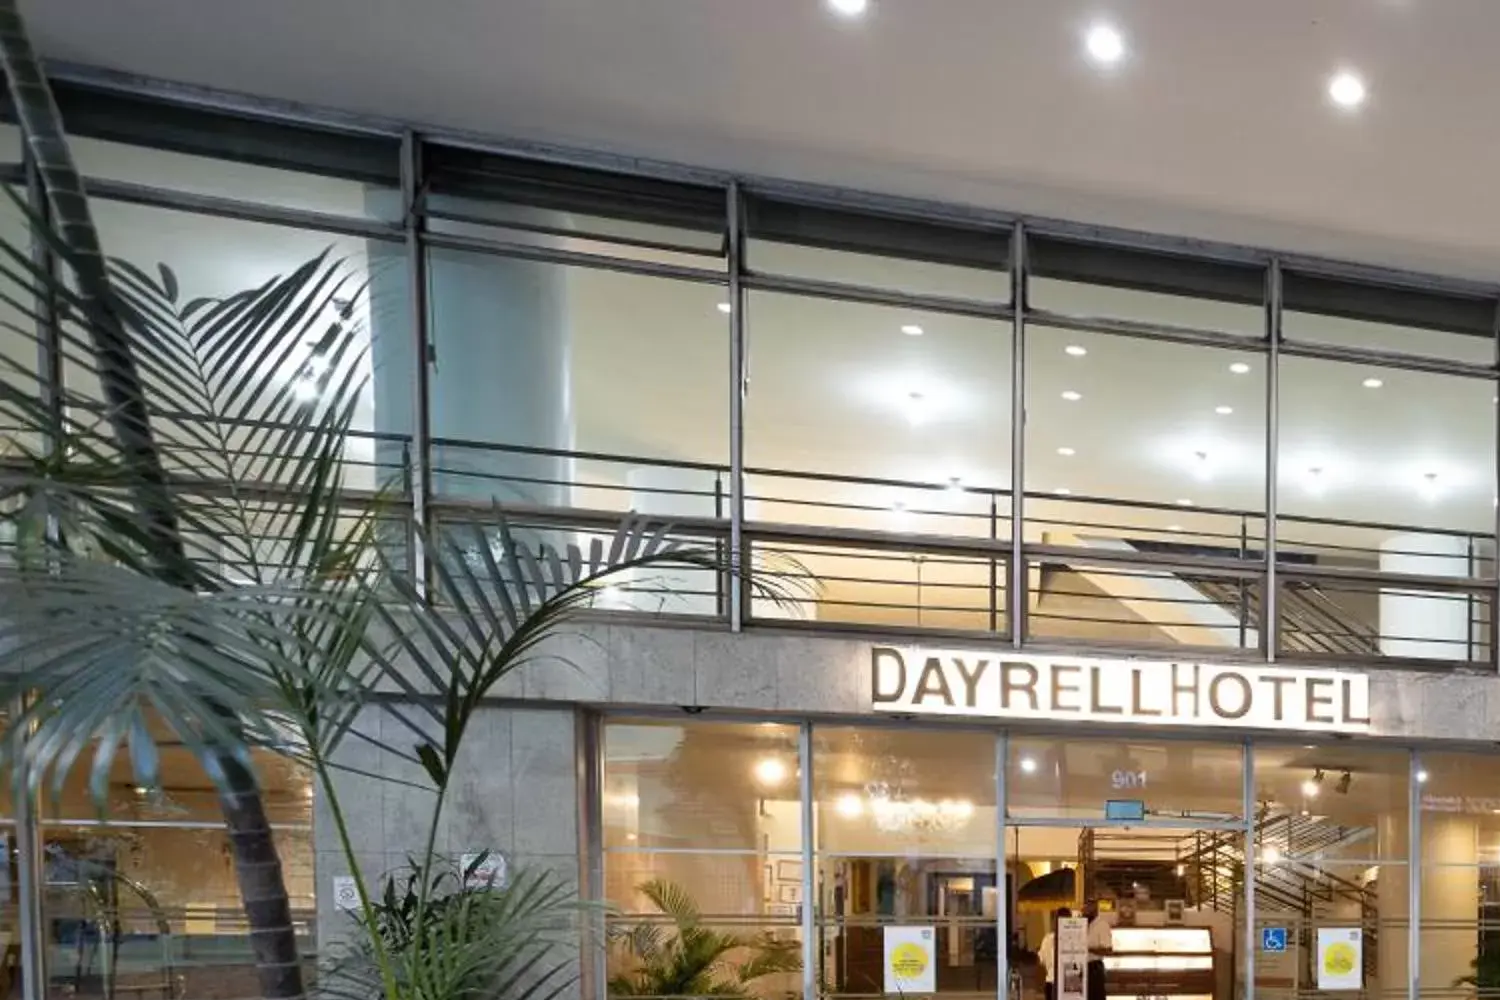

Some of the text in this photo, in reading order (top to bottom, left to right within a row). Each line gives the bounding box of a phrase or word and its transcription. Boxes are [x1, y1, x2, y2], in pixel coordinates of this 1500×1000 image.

[872, 647, 1370, 726] DAYRELL HOTEL
[1112, 769, 1147, 789] 901
